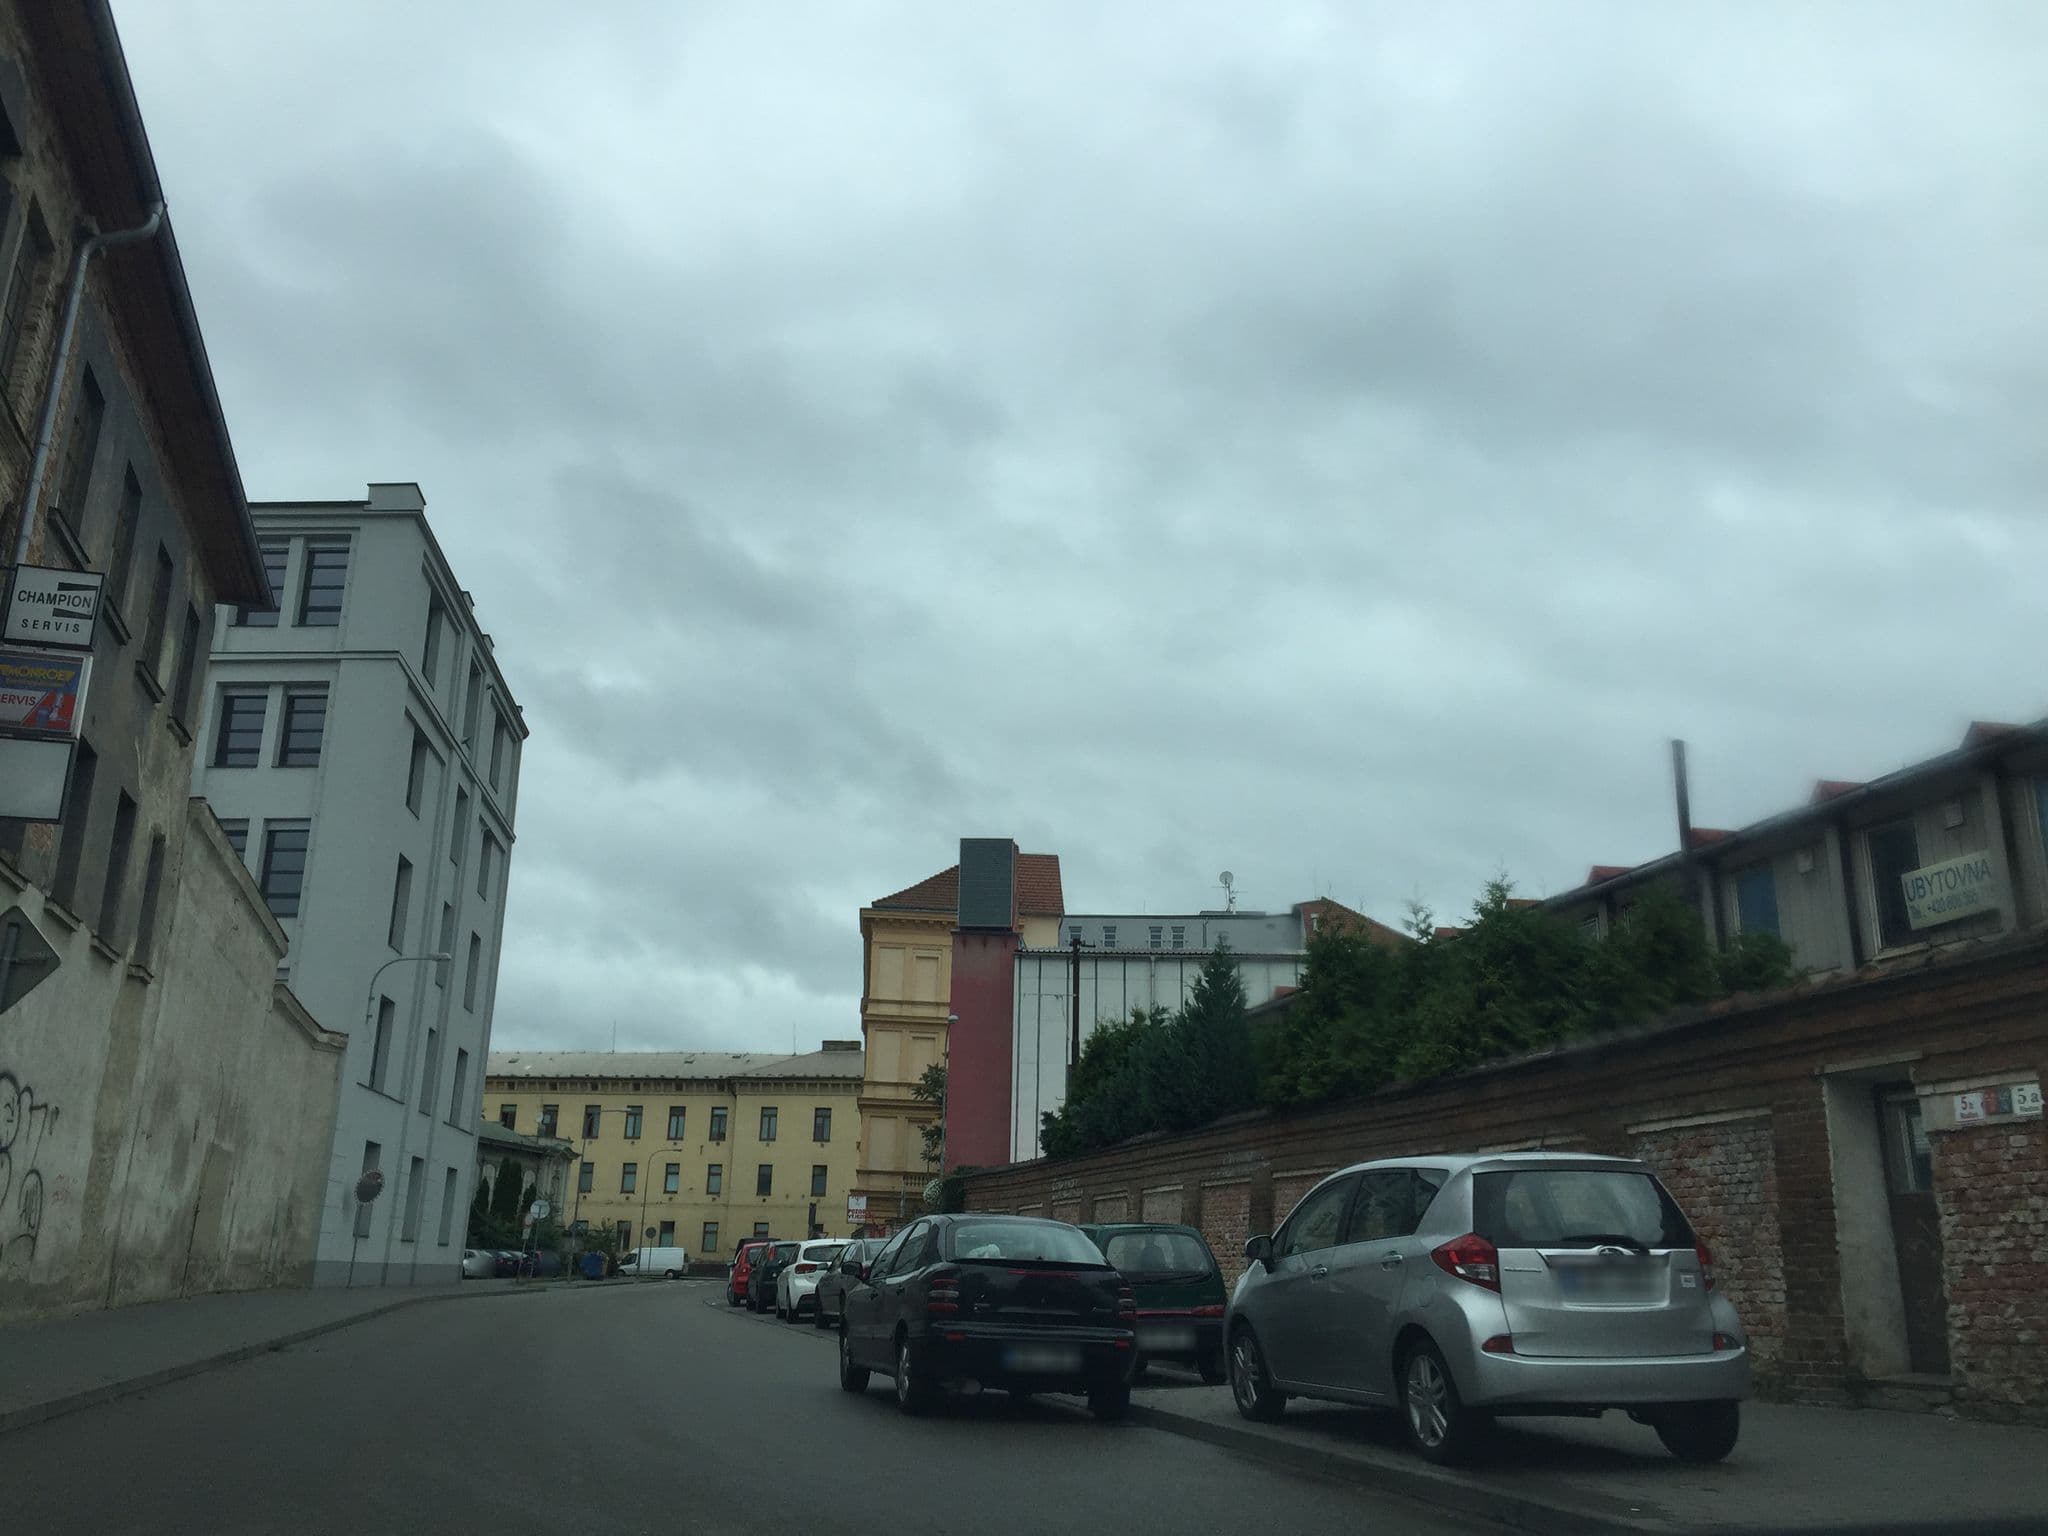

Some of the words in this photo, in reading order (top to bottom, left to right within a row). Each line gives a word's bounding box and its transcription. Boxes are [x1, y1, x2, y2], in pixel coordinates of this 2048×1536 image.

[17, 589, 92, 609] CHAMPION
[21, 618, 80, 633] SERVIS
[0, 693, 36, 706] ERVIS
[1904, 858, 1992, 901] UBYTOVNA
